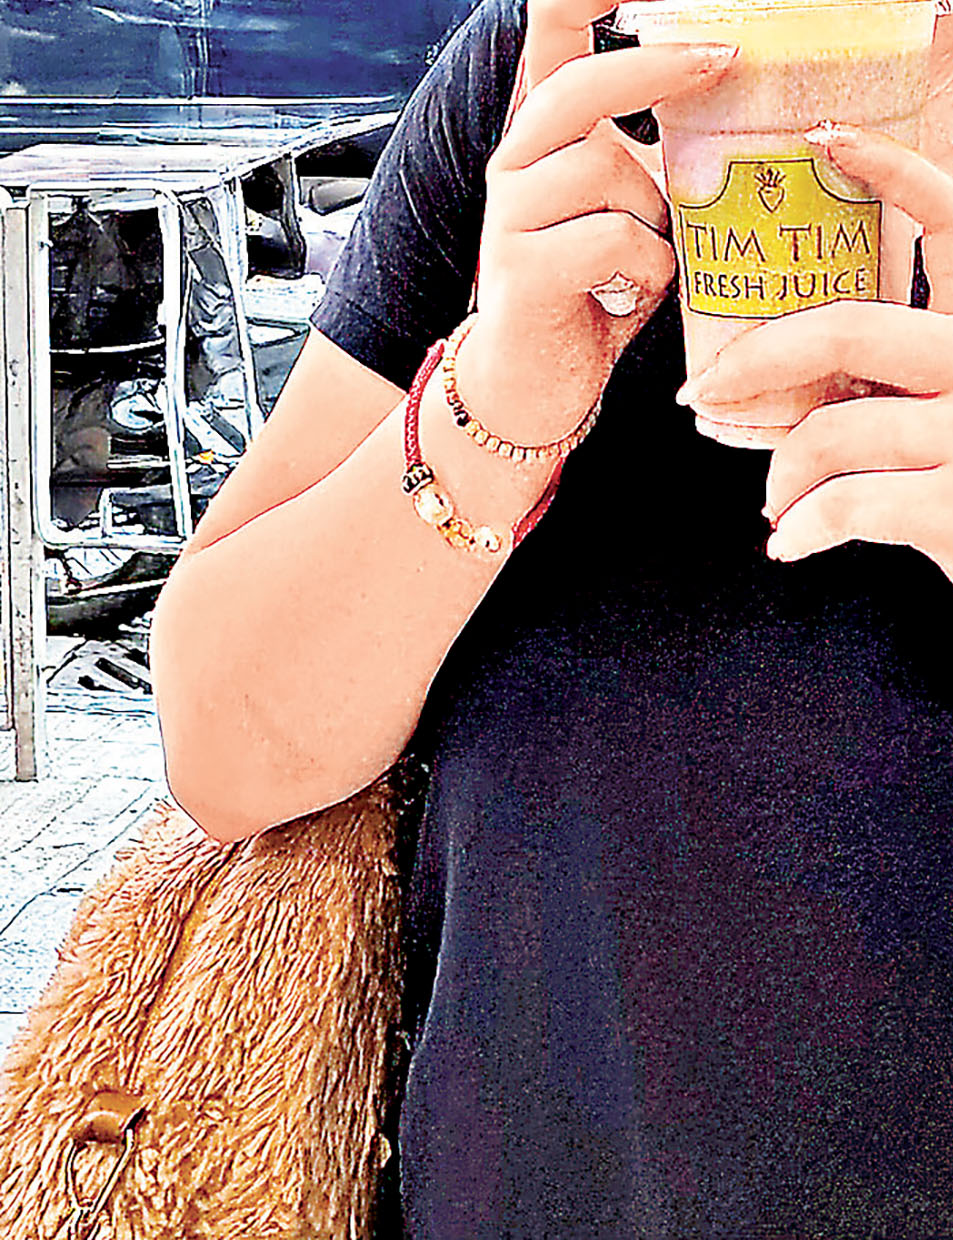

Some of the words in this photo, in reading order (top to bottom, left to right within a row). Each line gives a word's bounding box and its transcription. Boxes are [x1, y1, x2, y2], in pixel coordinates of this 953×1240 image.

[686, 220, 766, 262] TIM
[779, 220, 871, 262] TIM
[694, 271, 765, 300] FRESH
[776, 267, 867, 300] JUICE
